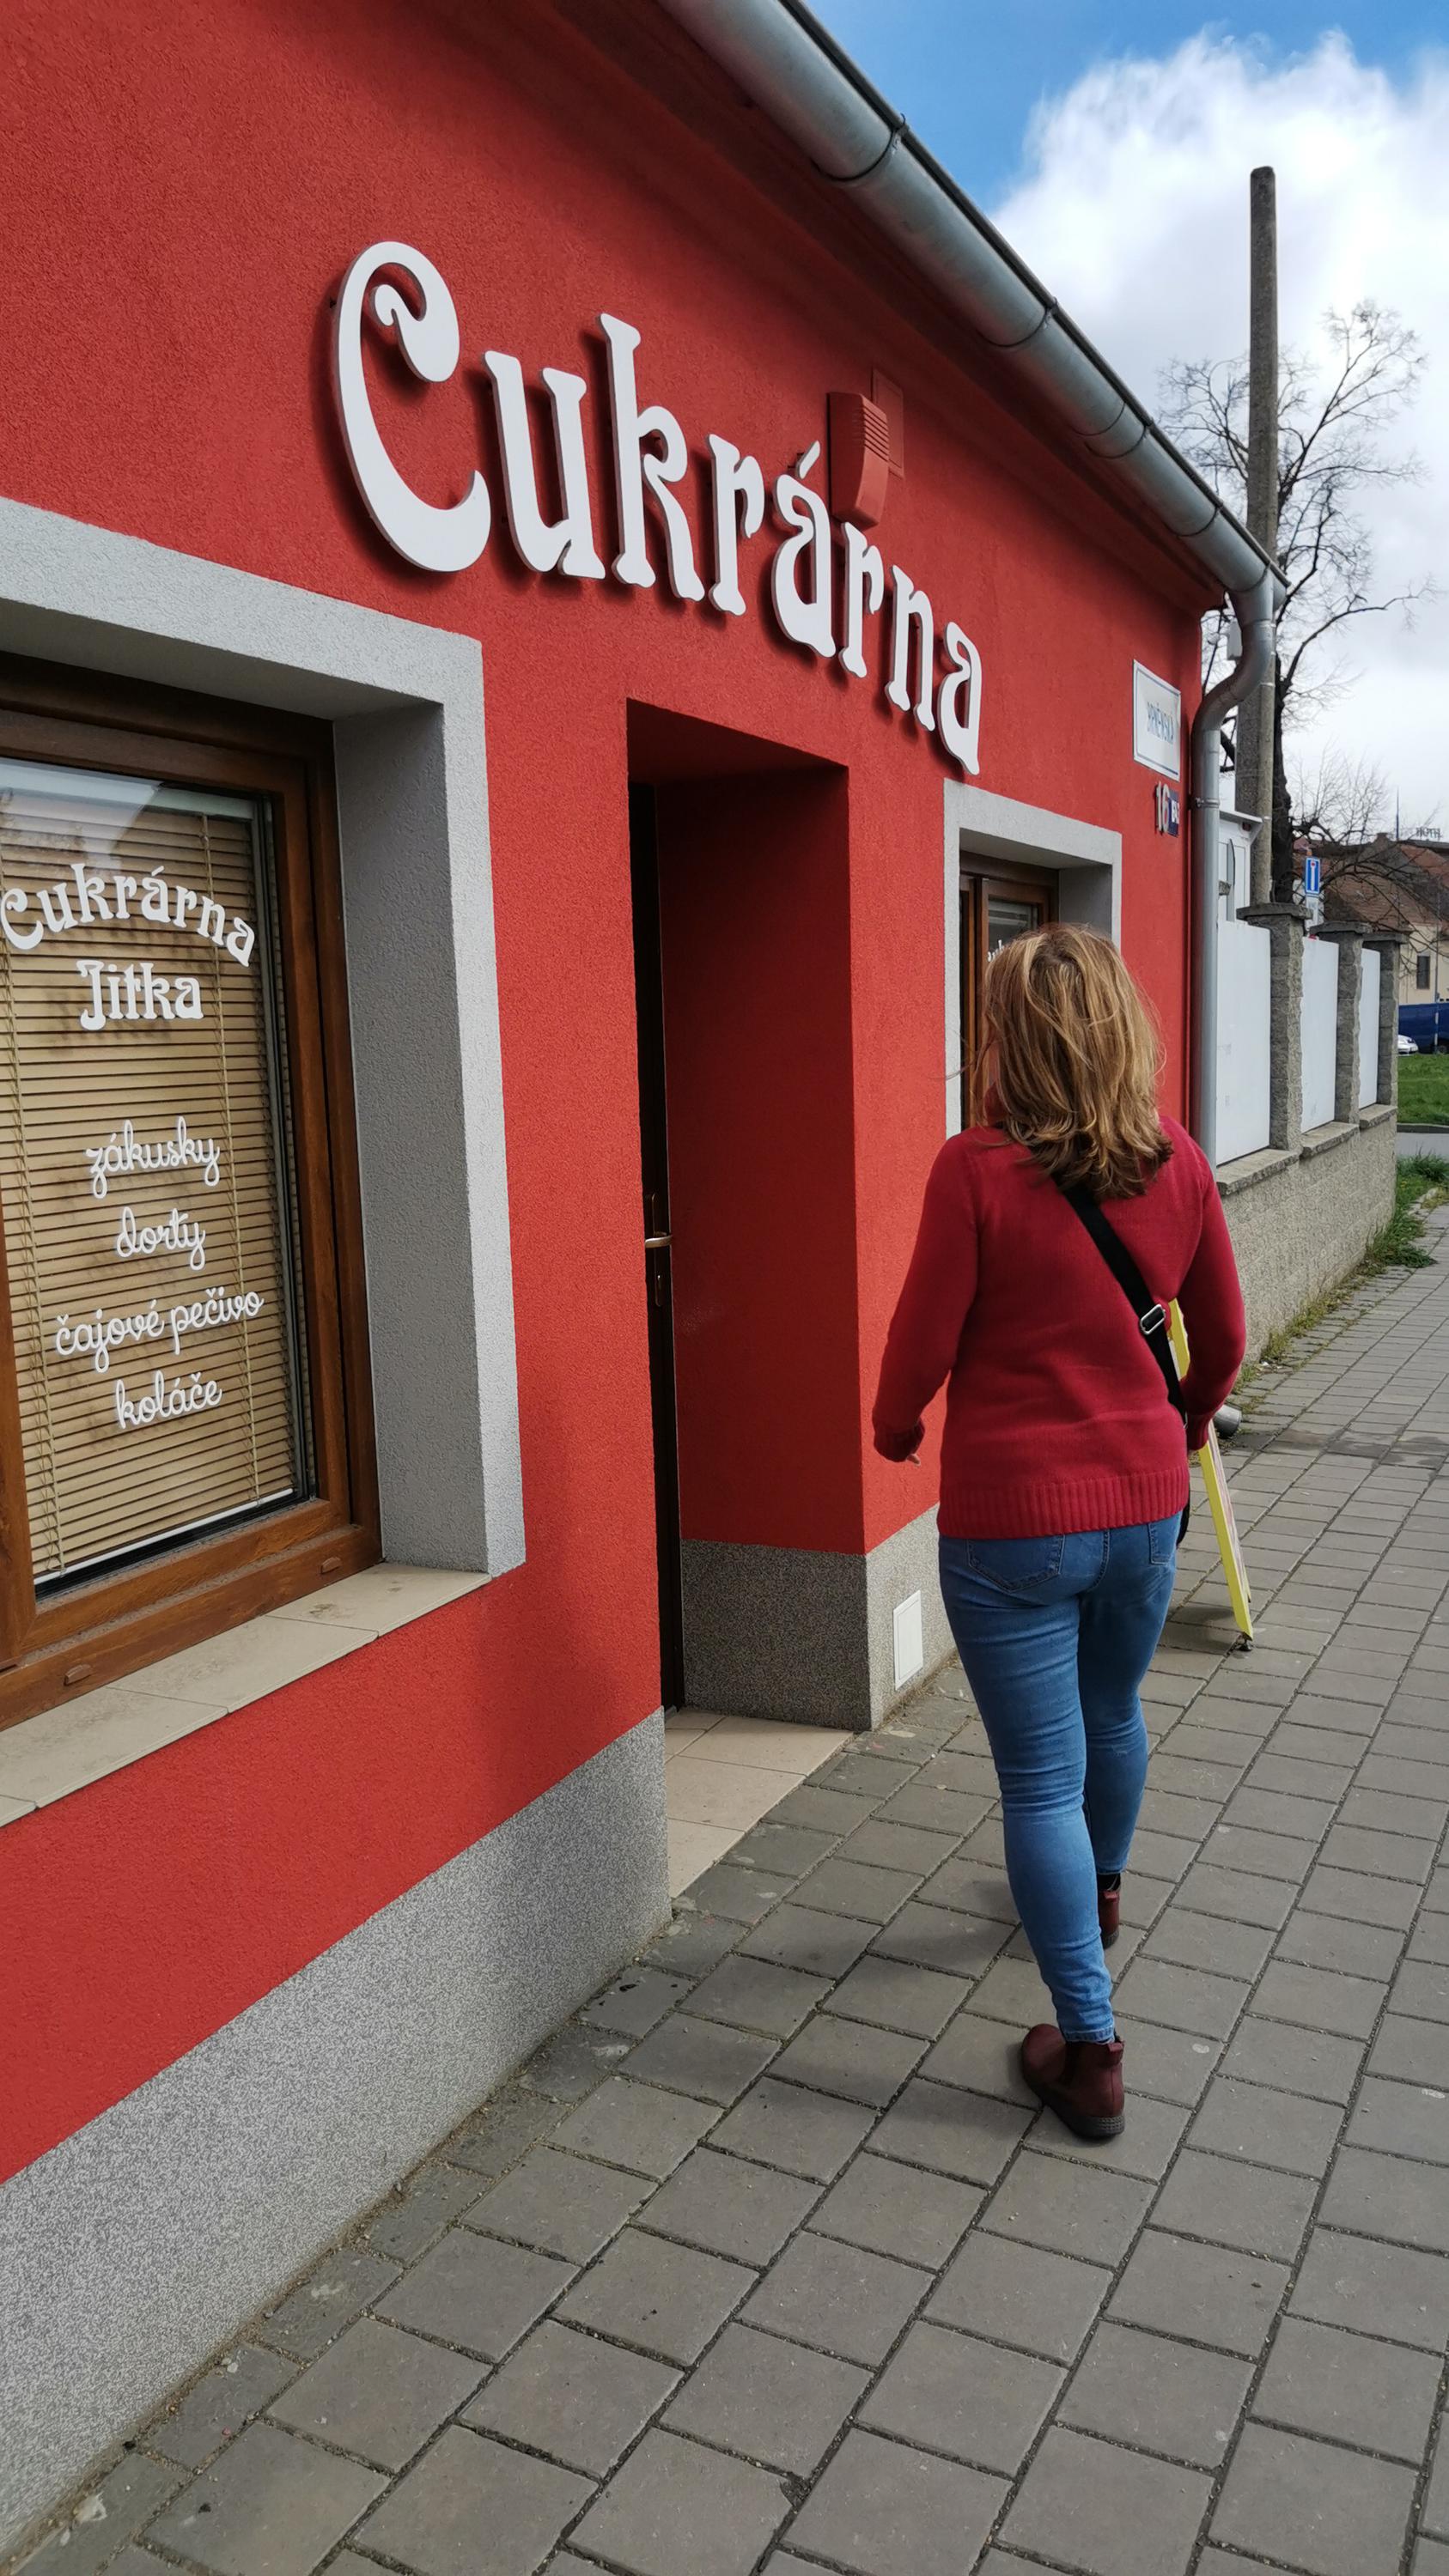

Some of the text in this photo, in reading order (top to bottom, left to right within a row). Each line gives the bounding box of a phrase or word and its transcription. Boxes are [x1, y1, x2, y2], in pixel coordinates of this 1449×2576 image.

[336, 240, 983, 777] Cukrárna
[0, 862, 255, 967] Cukrárna
[76, 959, 204, 1031] Jitka
[85, 1116, 221, 1199] zákusky
[116, 1206, 206, 1271] dorty
[55, 1285, 265, 1373] čajové pečivo
[114, 1370, 222, 1430] koláče
